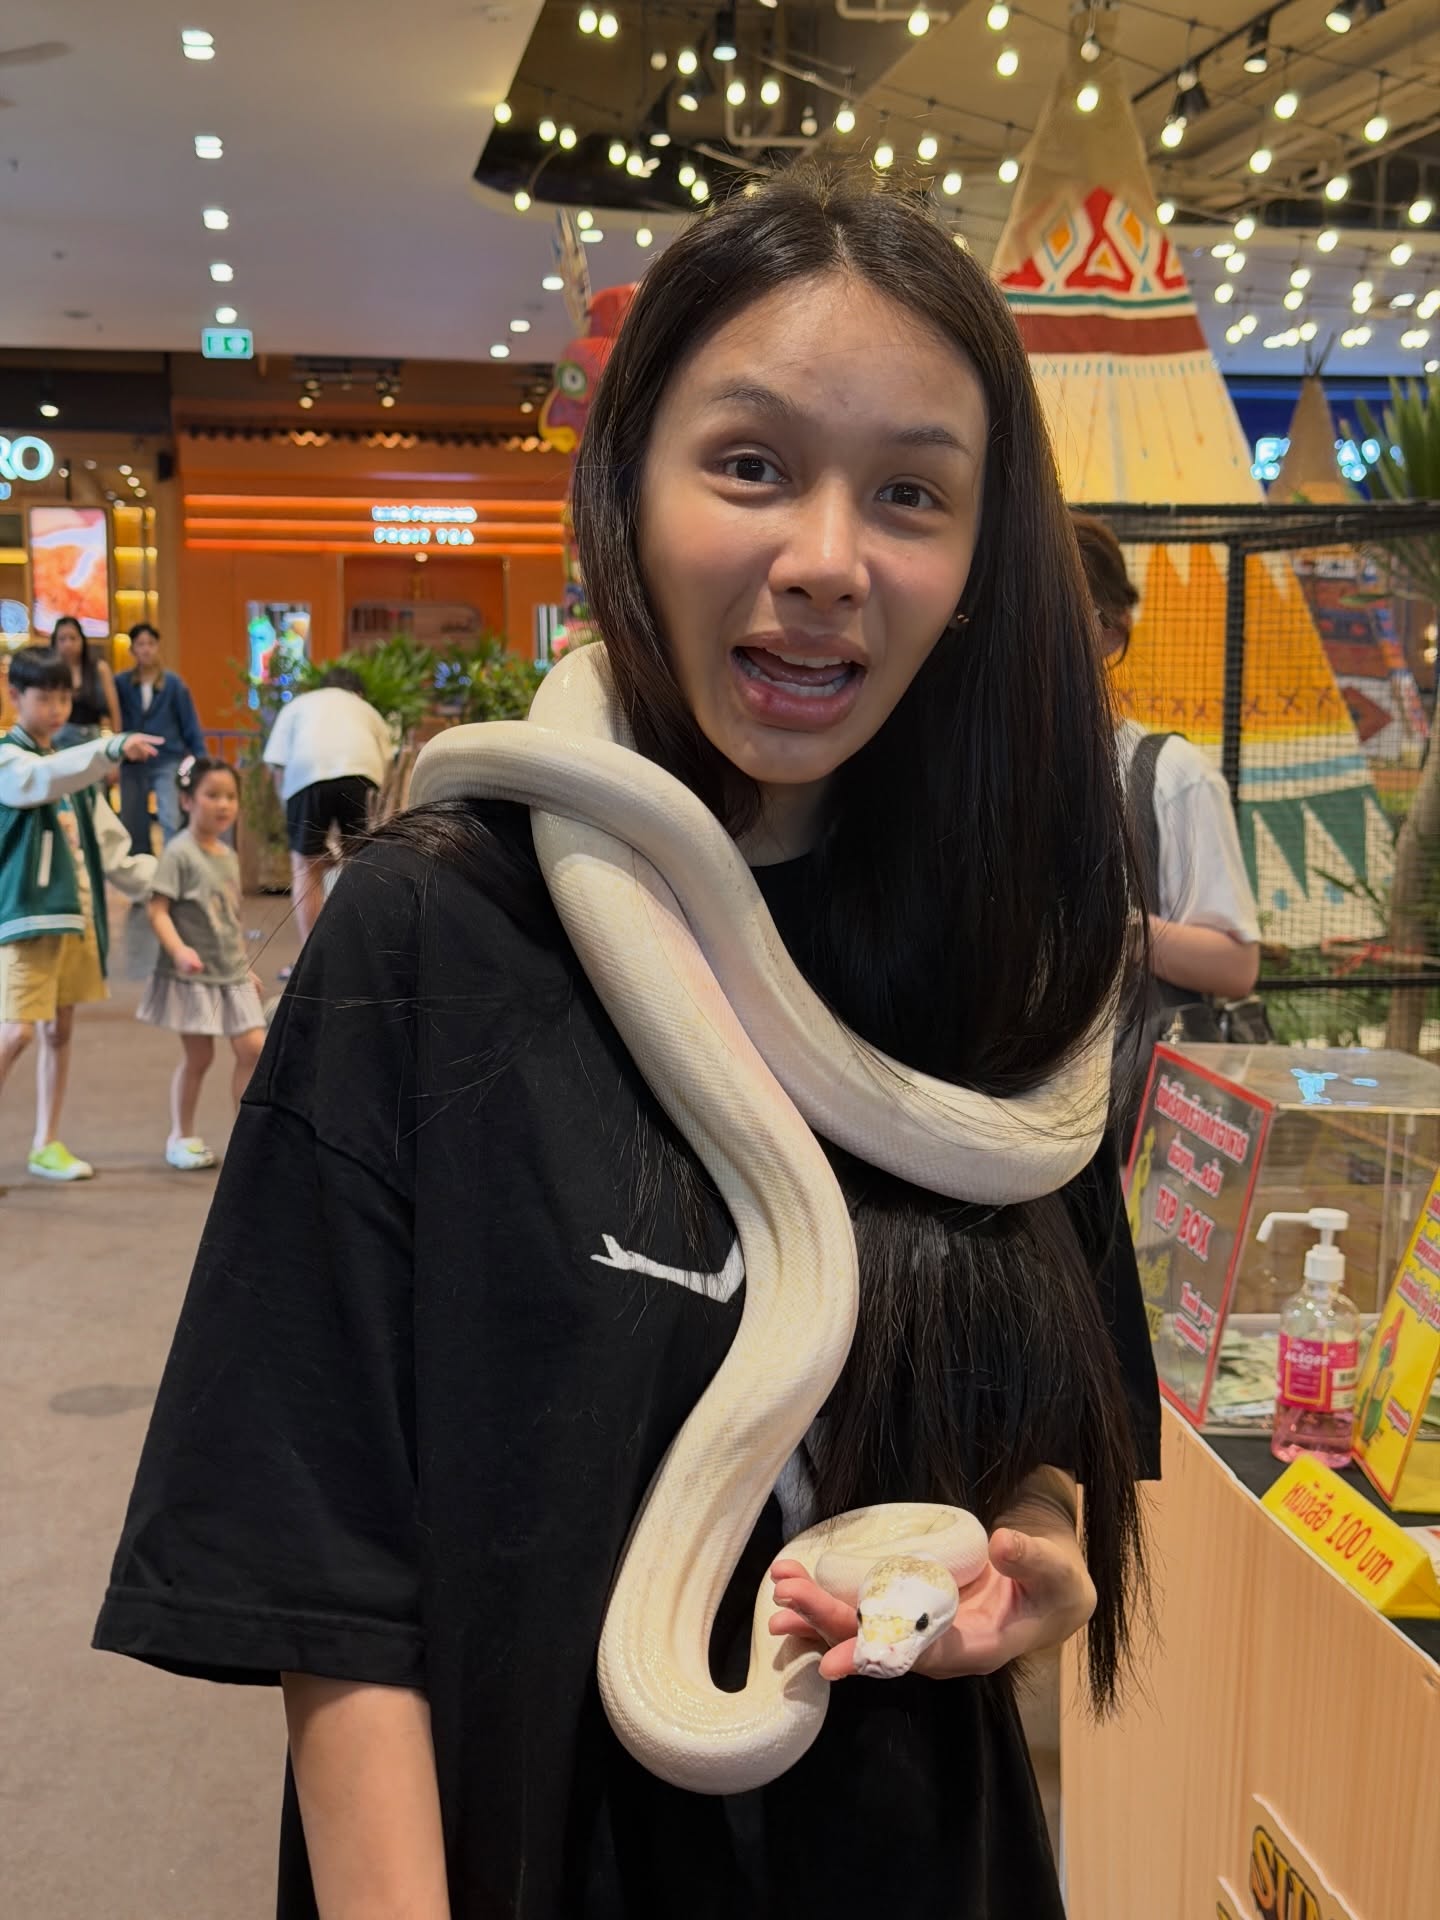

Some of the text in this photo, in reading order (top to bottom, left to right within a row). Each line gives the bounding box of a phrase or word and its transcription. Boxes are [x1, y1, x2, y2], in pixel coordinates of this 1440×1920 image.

[1155, 1184, 1215, 1261] TIP BOX
[1324, 1511, 1373, 1560] 100
[1357, 1545, 1395, 1585] บาท
